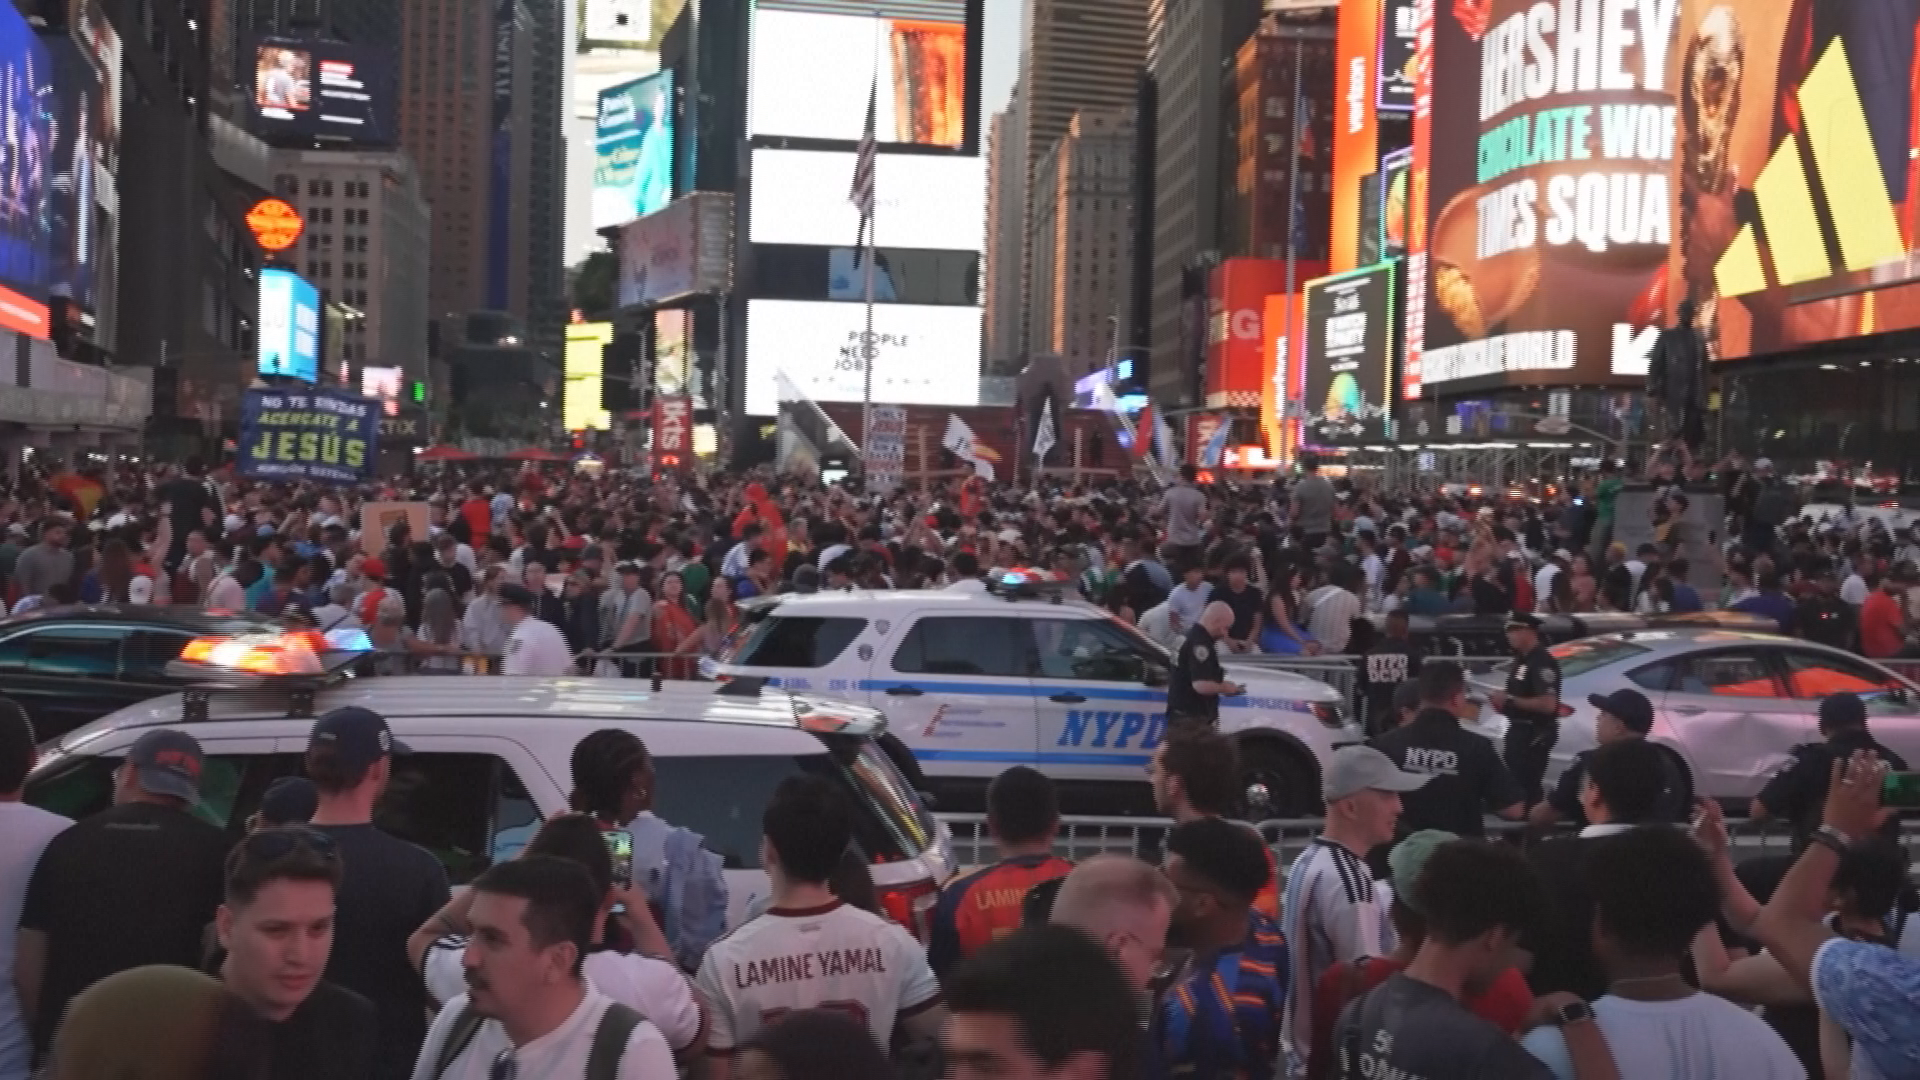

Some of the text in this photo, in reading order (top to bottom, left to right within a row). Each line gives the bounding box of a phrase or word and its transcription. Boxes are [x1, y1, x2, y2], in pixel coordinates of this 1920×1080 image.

[848, 331, 908, 347] PEOPLE
[840, 345, 879, 359] NEED
[834, 358, 873, 371] JOB
[261, 396, 283, 408] NO
[288, 396, 308, 408] TE
[345, 419, 359, 431] A
[251, 430, 366, 467] JESÚS
[1367, 654, 1409, 669] NYPD
[1250, 698, 1290, 711] POLICE
[1058, 711, 1166, 749] NYPD
[1406, 747, 1458, 769] NYPD
[734, 948, 886, 989] LAMINE YAMAL
